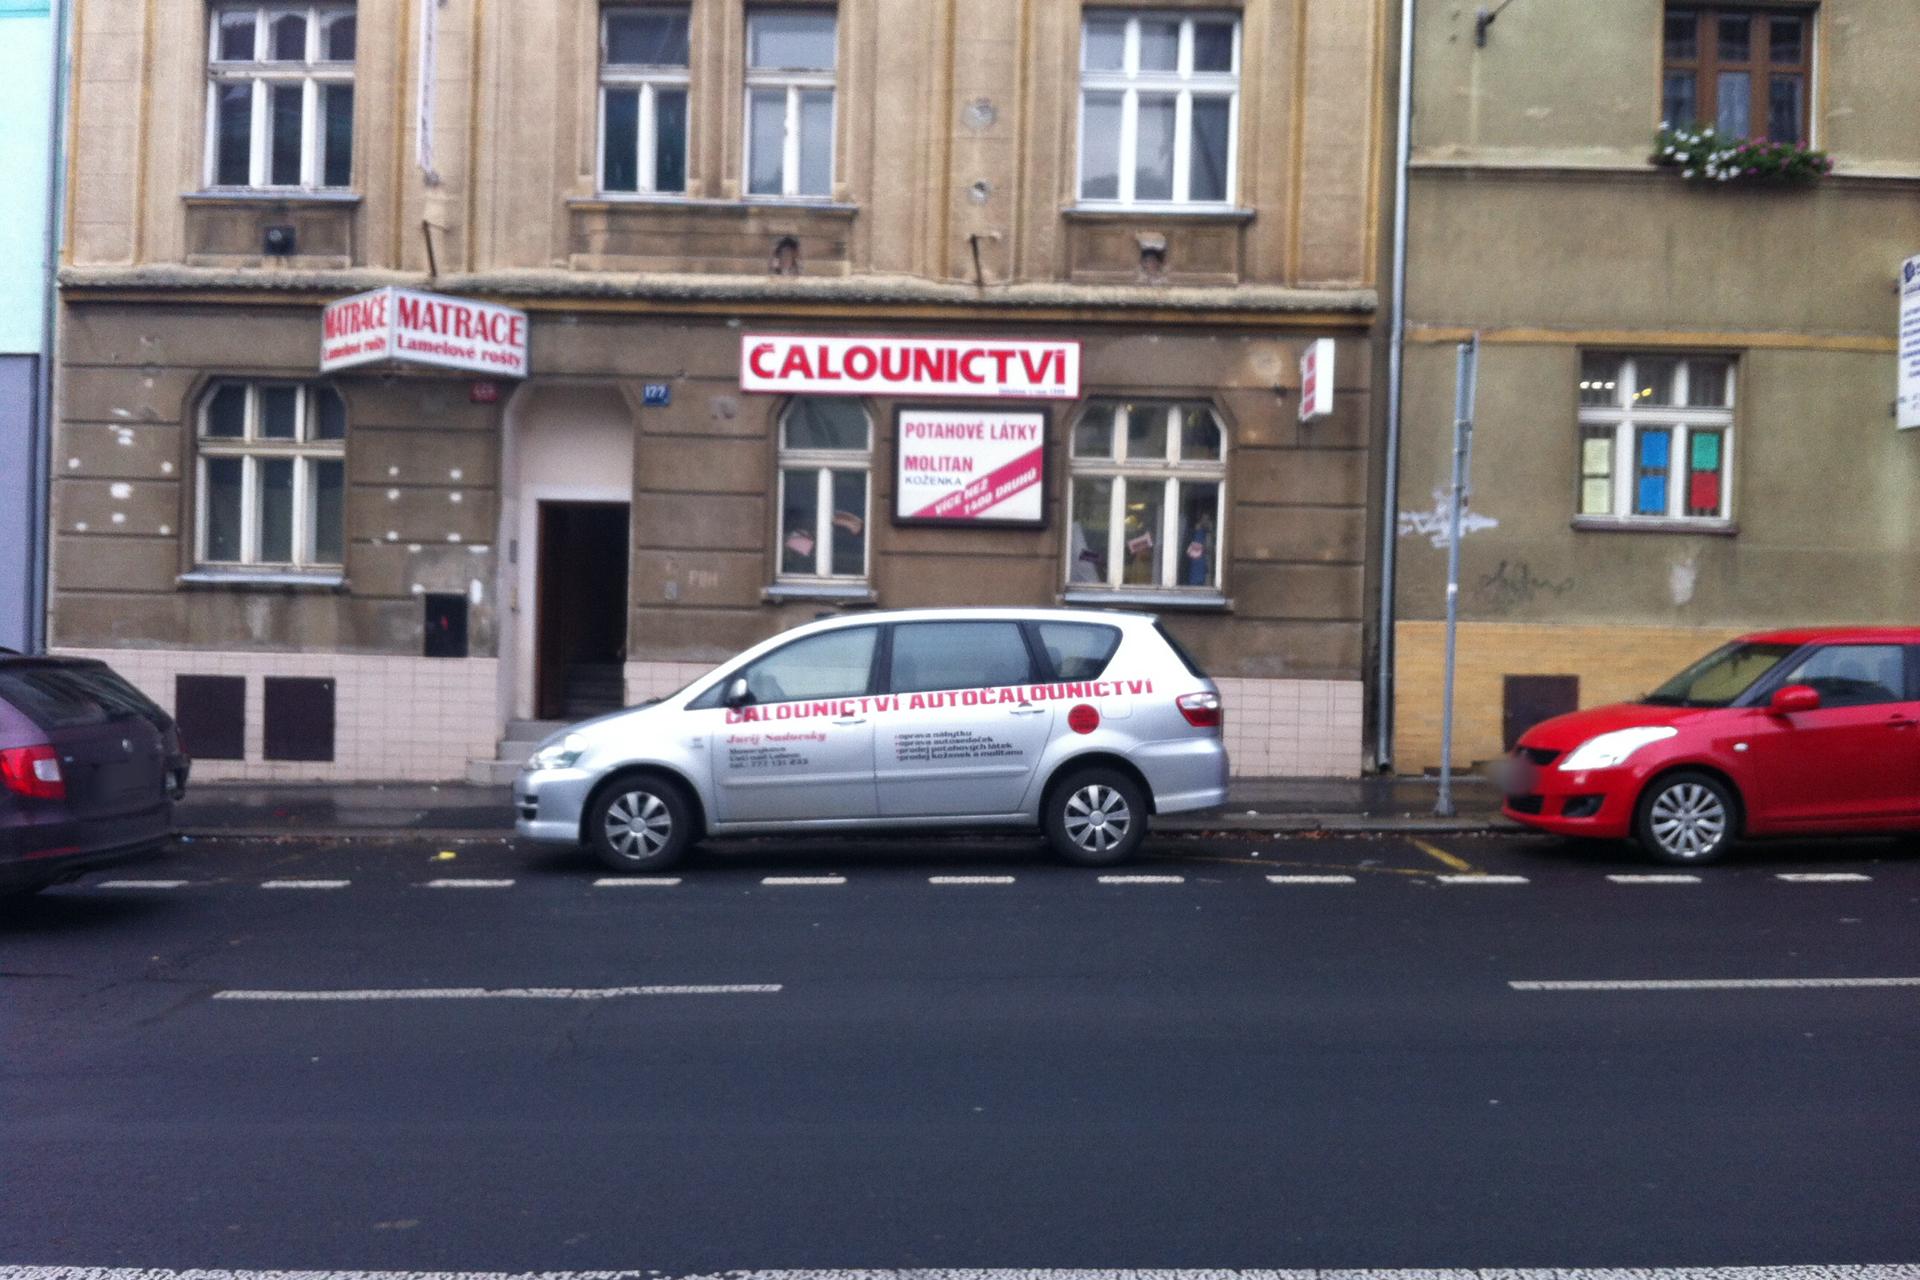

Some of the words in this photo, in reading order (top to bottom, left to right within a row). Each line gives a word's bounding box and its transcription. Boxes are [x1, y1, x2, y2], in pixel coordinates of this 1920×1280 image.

[324, 294, 389, 339] MATRACE
[398, 296, 525, 348] MATRACE
[397, 334, 475, 359] Lamelové
[481, 348, 521, 368] rošty
[749, 343, 1066, 385] ČALOUNICTVÍ
[905, 420, 984, 439] POTAHOVÉ
[990, 421, 1037, 440] LÁTKY
[905, 455, 973, 472] MOLITAN
[905, 474, 962, 486] KOŽENKA
[909, 679, 1153, 710] AUTOČALOUNICTVÍ
